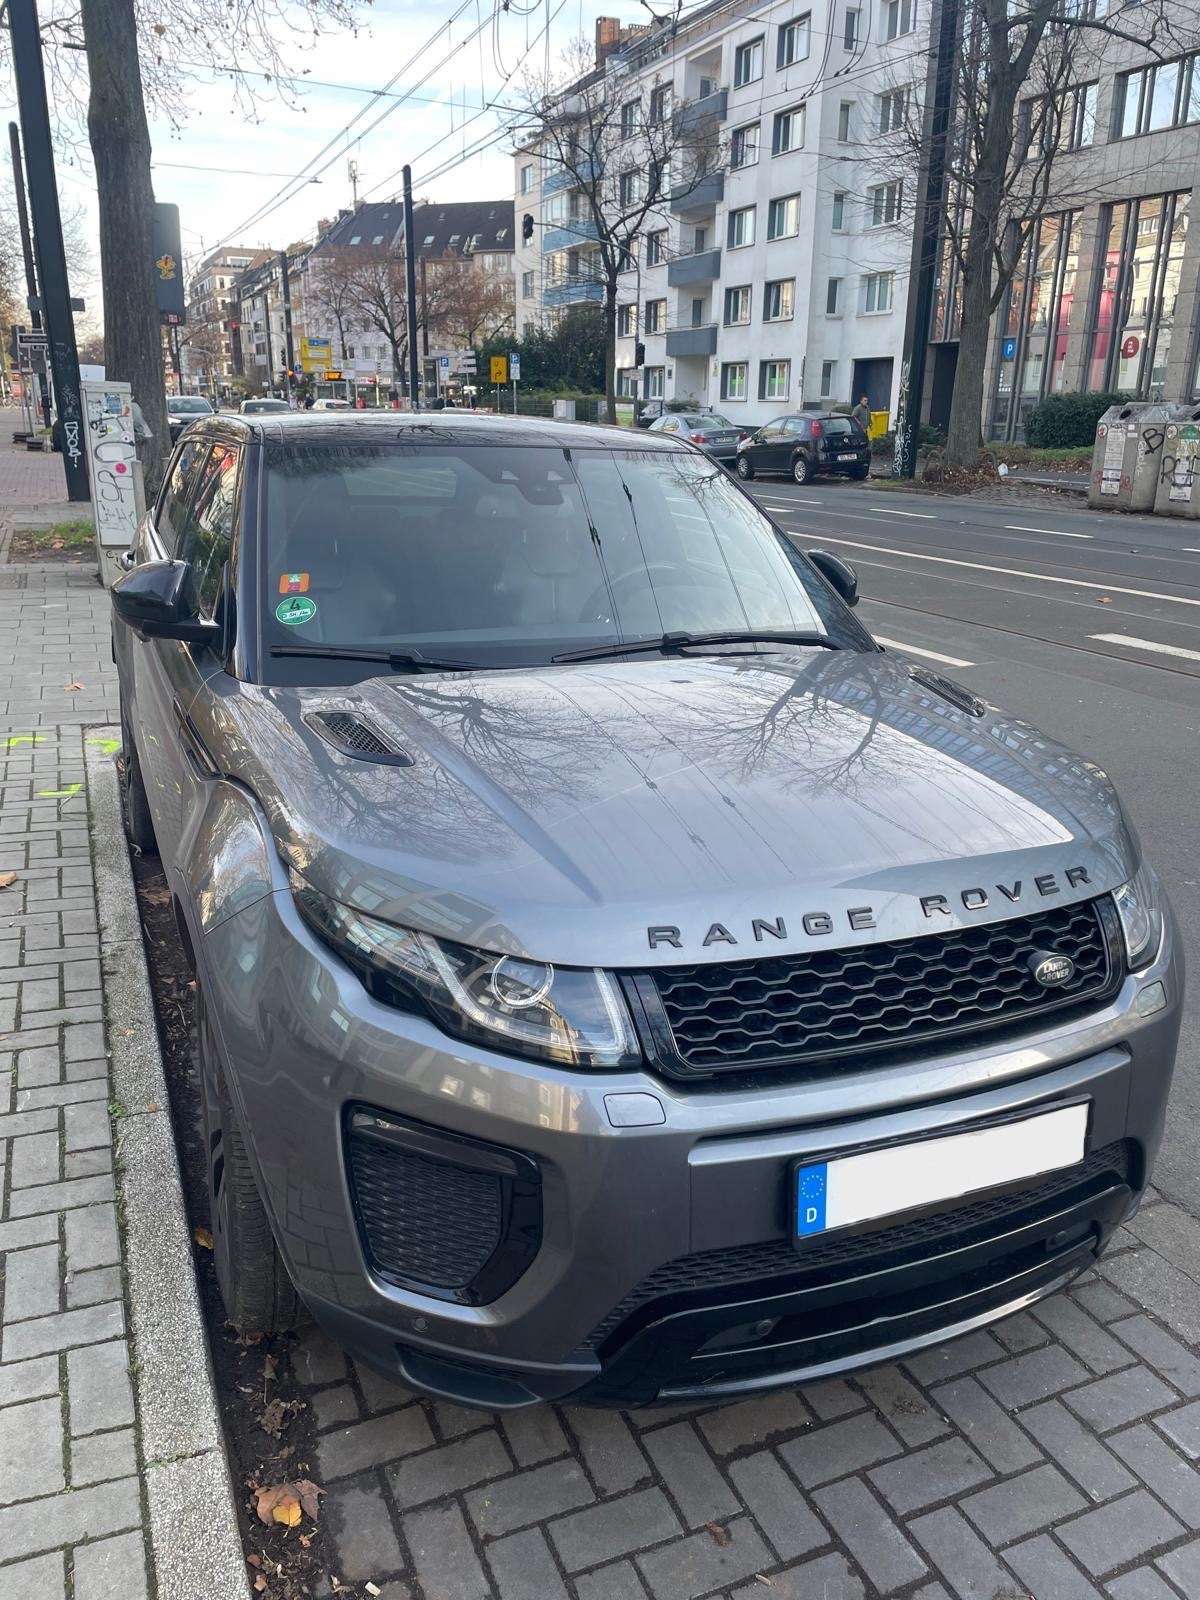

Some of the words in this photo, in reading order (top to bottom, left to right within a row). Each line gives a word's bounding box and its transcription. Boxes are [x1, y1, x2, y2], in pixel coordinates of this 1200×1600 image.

[290, 599, 301, 611] 4
[647, 906, 877, 949] RANGE
[919, 865, 1093, 918] ROVER
[1043, 961, 1063, 974] LAND
[1047, 968, 1070, 981] ROVER
[806, 1207, 817, 1224] D
